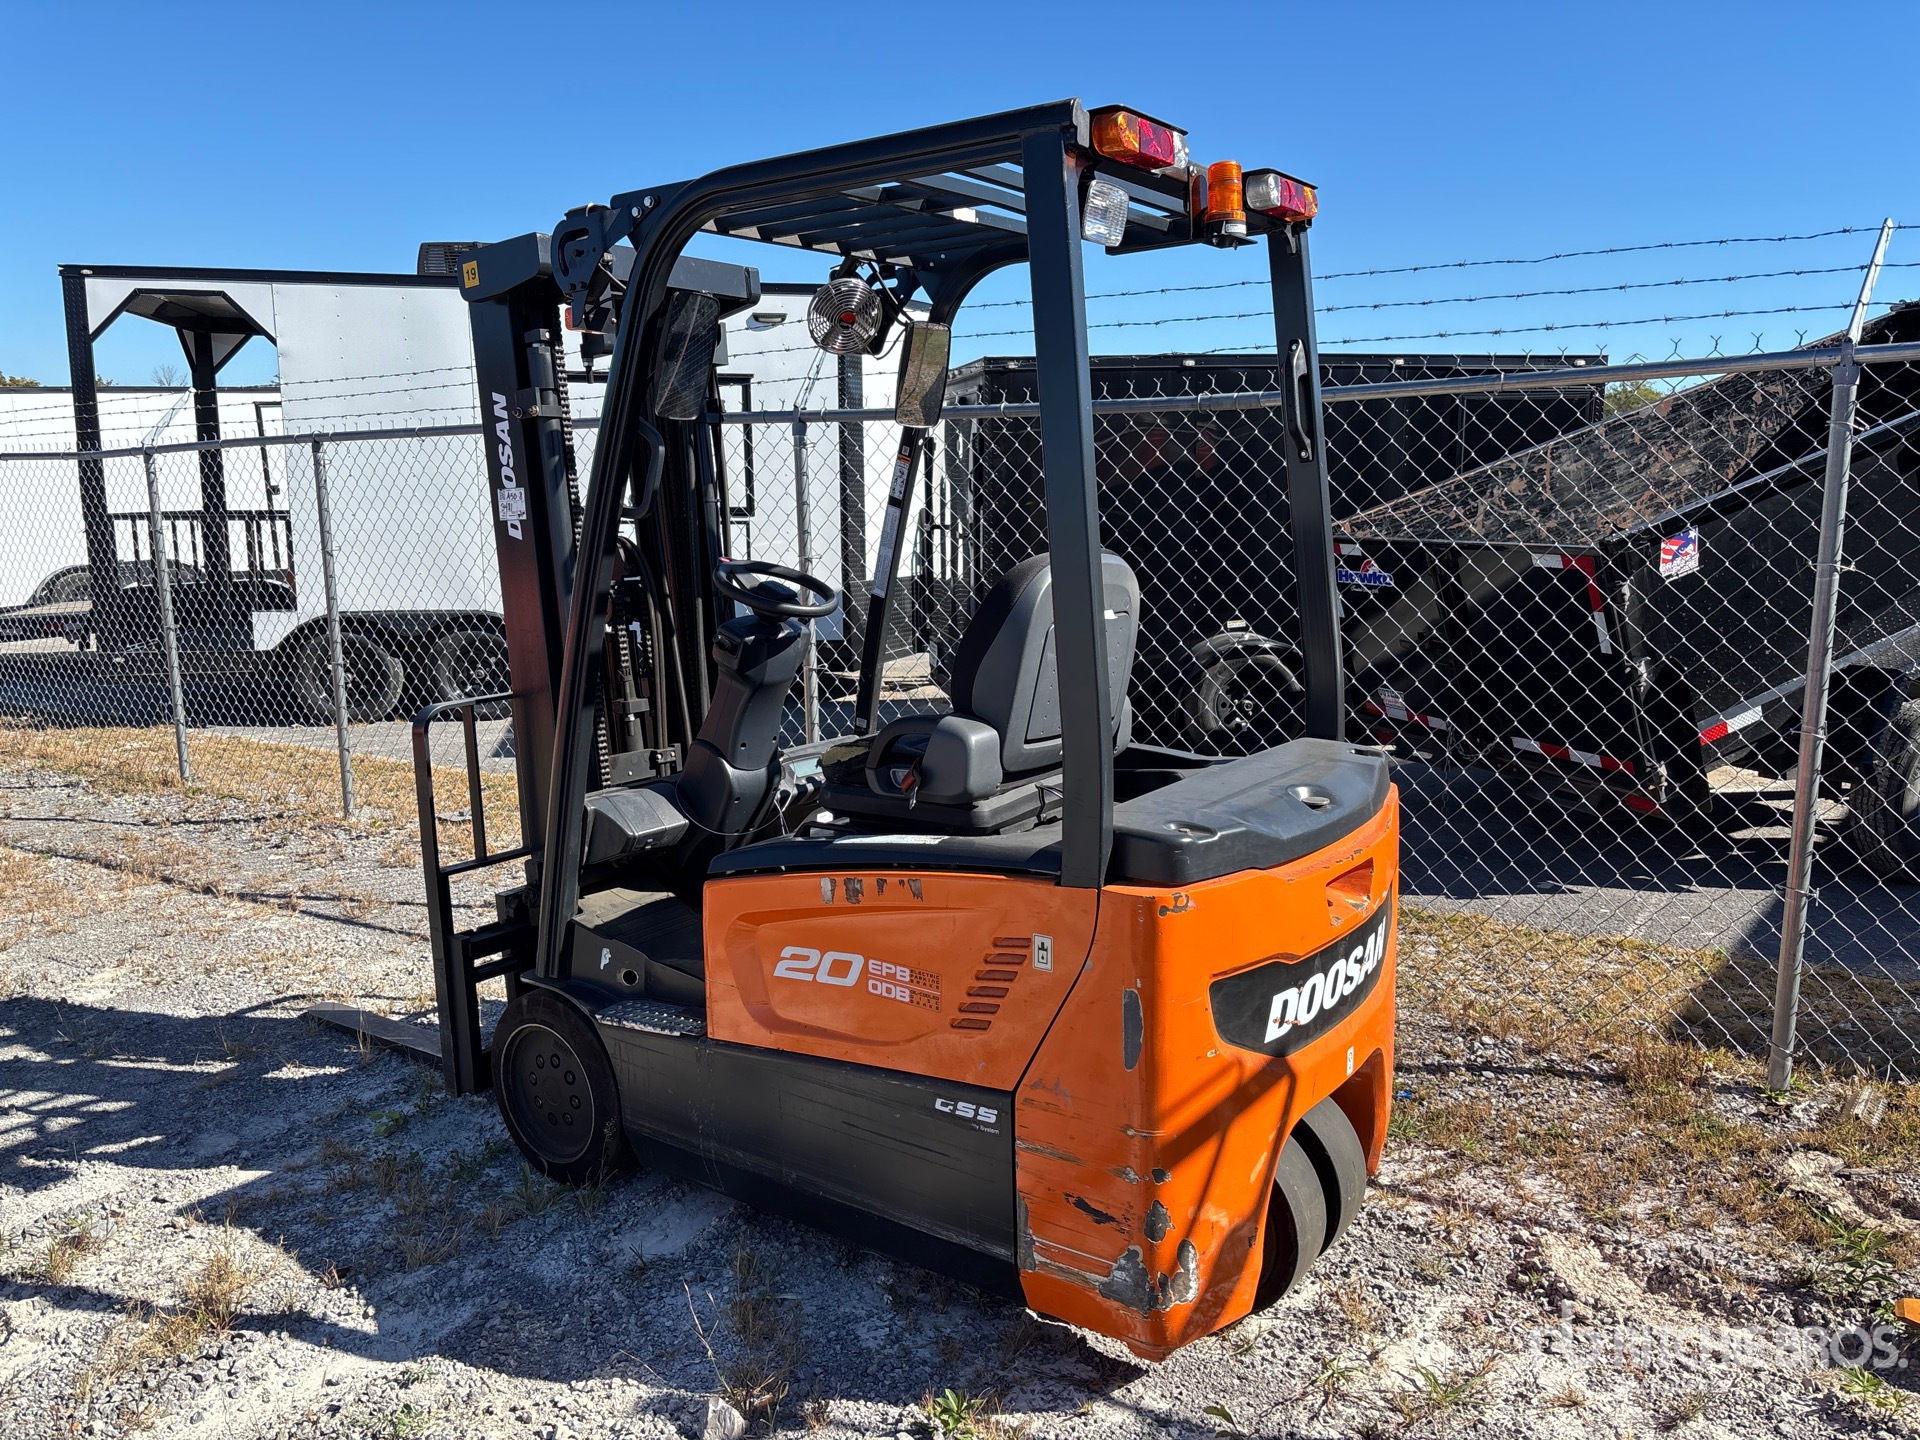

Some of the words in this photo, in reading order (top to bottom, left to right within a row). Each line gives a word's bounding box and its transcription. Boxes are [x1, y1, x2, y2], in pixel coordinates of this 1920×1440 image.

[465, 267, 477, 281] 19
[492, 391, 523, 541] DOSAN
[773, 945, 865, 987] 20
[868, 959, 910, 982] EPB
[910, 969, 940, 980] ELECTRIC
[868, 979, 910, 1003] ODB
[1264, 915, 1386, 1044] DOOSAN
